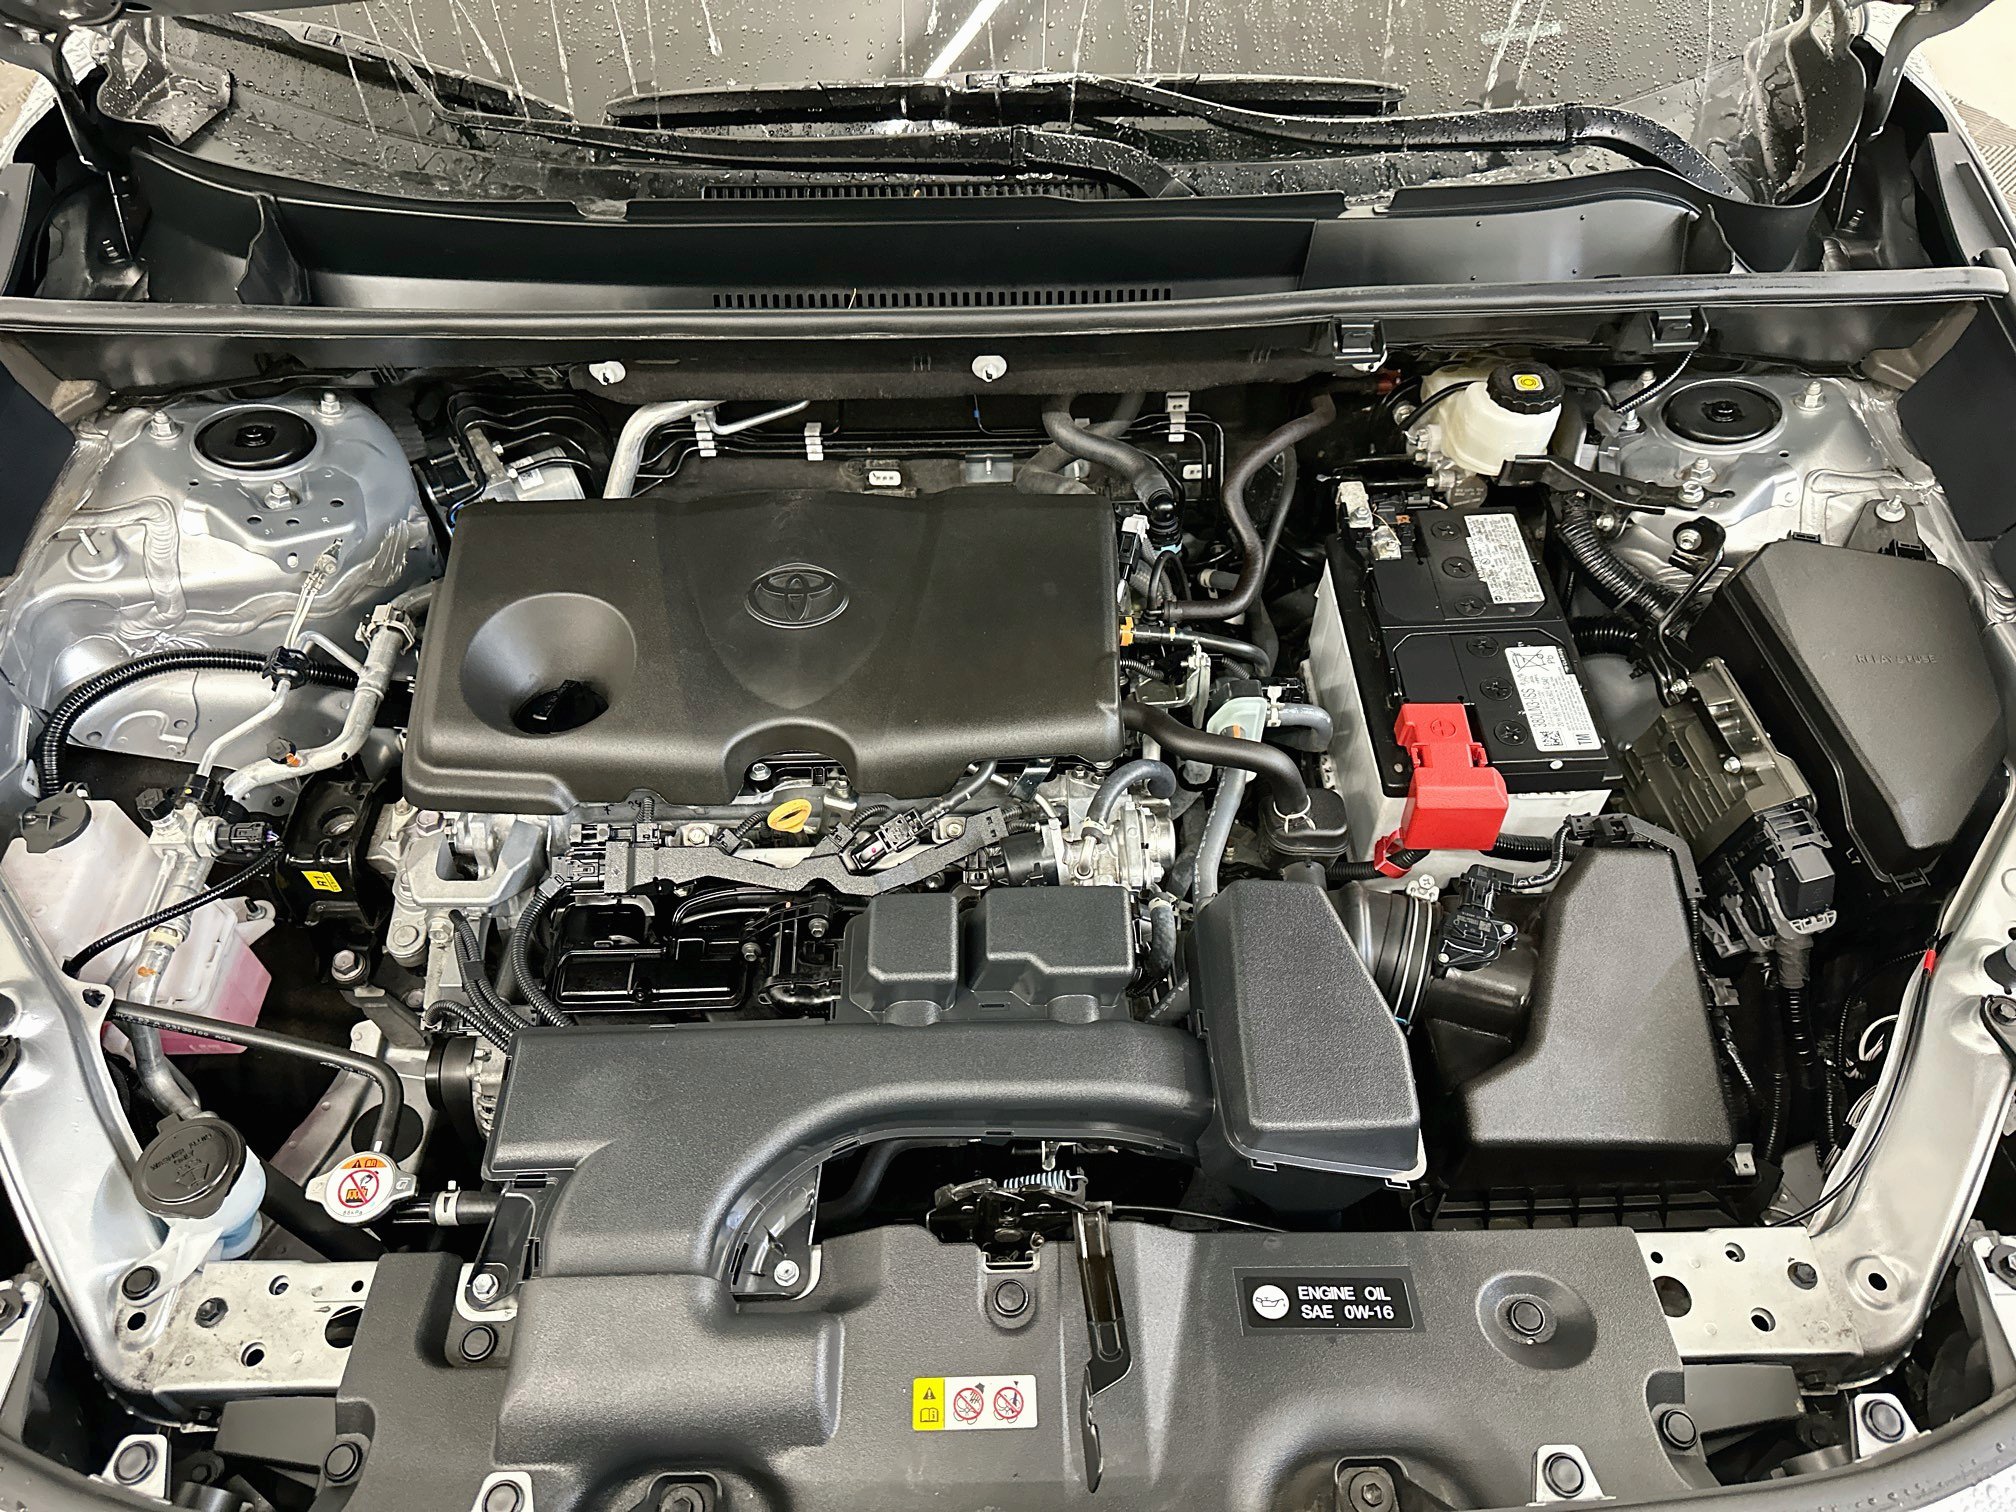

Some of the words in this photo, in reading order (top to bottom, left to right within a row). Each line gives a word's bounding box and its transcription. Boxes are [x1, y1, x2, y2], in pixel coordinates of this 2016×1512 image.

[1297, 1286, 1356, 1301] ENGINE
[1364, 1286, 1392, 1301] OIL
[1301, 1304, 1335, 1319] SAE
[1344, 1304, 1395, 1320] 0W-16
